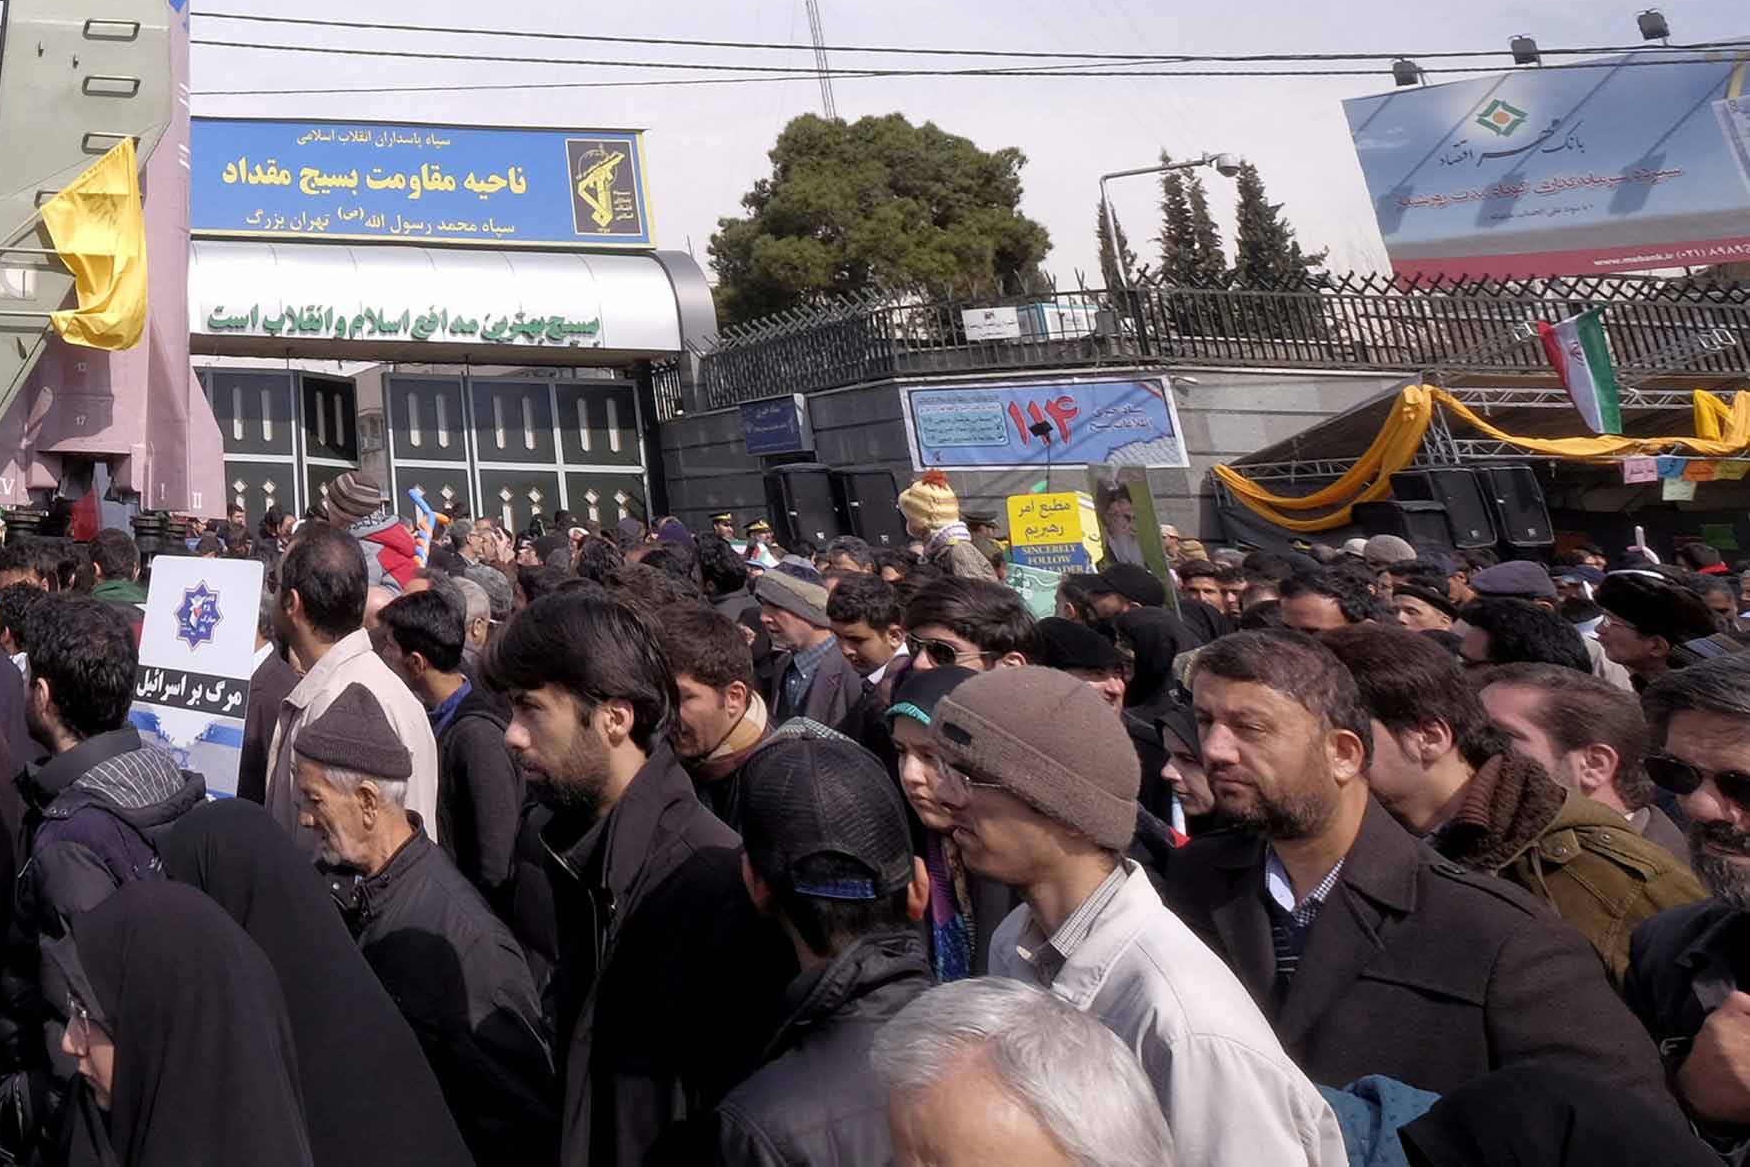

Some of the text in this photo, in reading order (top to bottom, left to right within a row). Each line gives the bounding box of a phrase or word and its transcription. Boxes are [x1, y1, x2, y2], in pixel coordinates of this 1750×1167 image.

[296, 129, 451, 149] سپاه پاسداران انقلاب اسلامی
[221, 156, 528, 200] ناحیه مقاومت بسیج مقداد
[245, 208, 285, 230] بزرگ
[289, 210, 330, 230] تهران
[389, 214, 432, 234] رسول
[436, 217, 478, 233] محمد
[481, 218, 515, 238] سپاه
[207, 303, 259, 331] است
[262, 304, 334, 336] انقلاب
[349, 307, 410, 341] اسلام
[410, 306, 480, 341] مدافع
[480, 312, 546, 347] بهترین
[545, 314, 600, 348] بسیج
[1018, 501, 1035, 517] امر
[1025, 522, 1064, 539] رهبریم
[1020, 544, 1076, 554] SINCERELY
[1027, 555, 1071, 566] FOLLOW
[136, 669, 242, 712] مرگ بر اسرائیل
